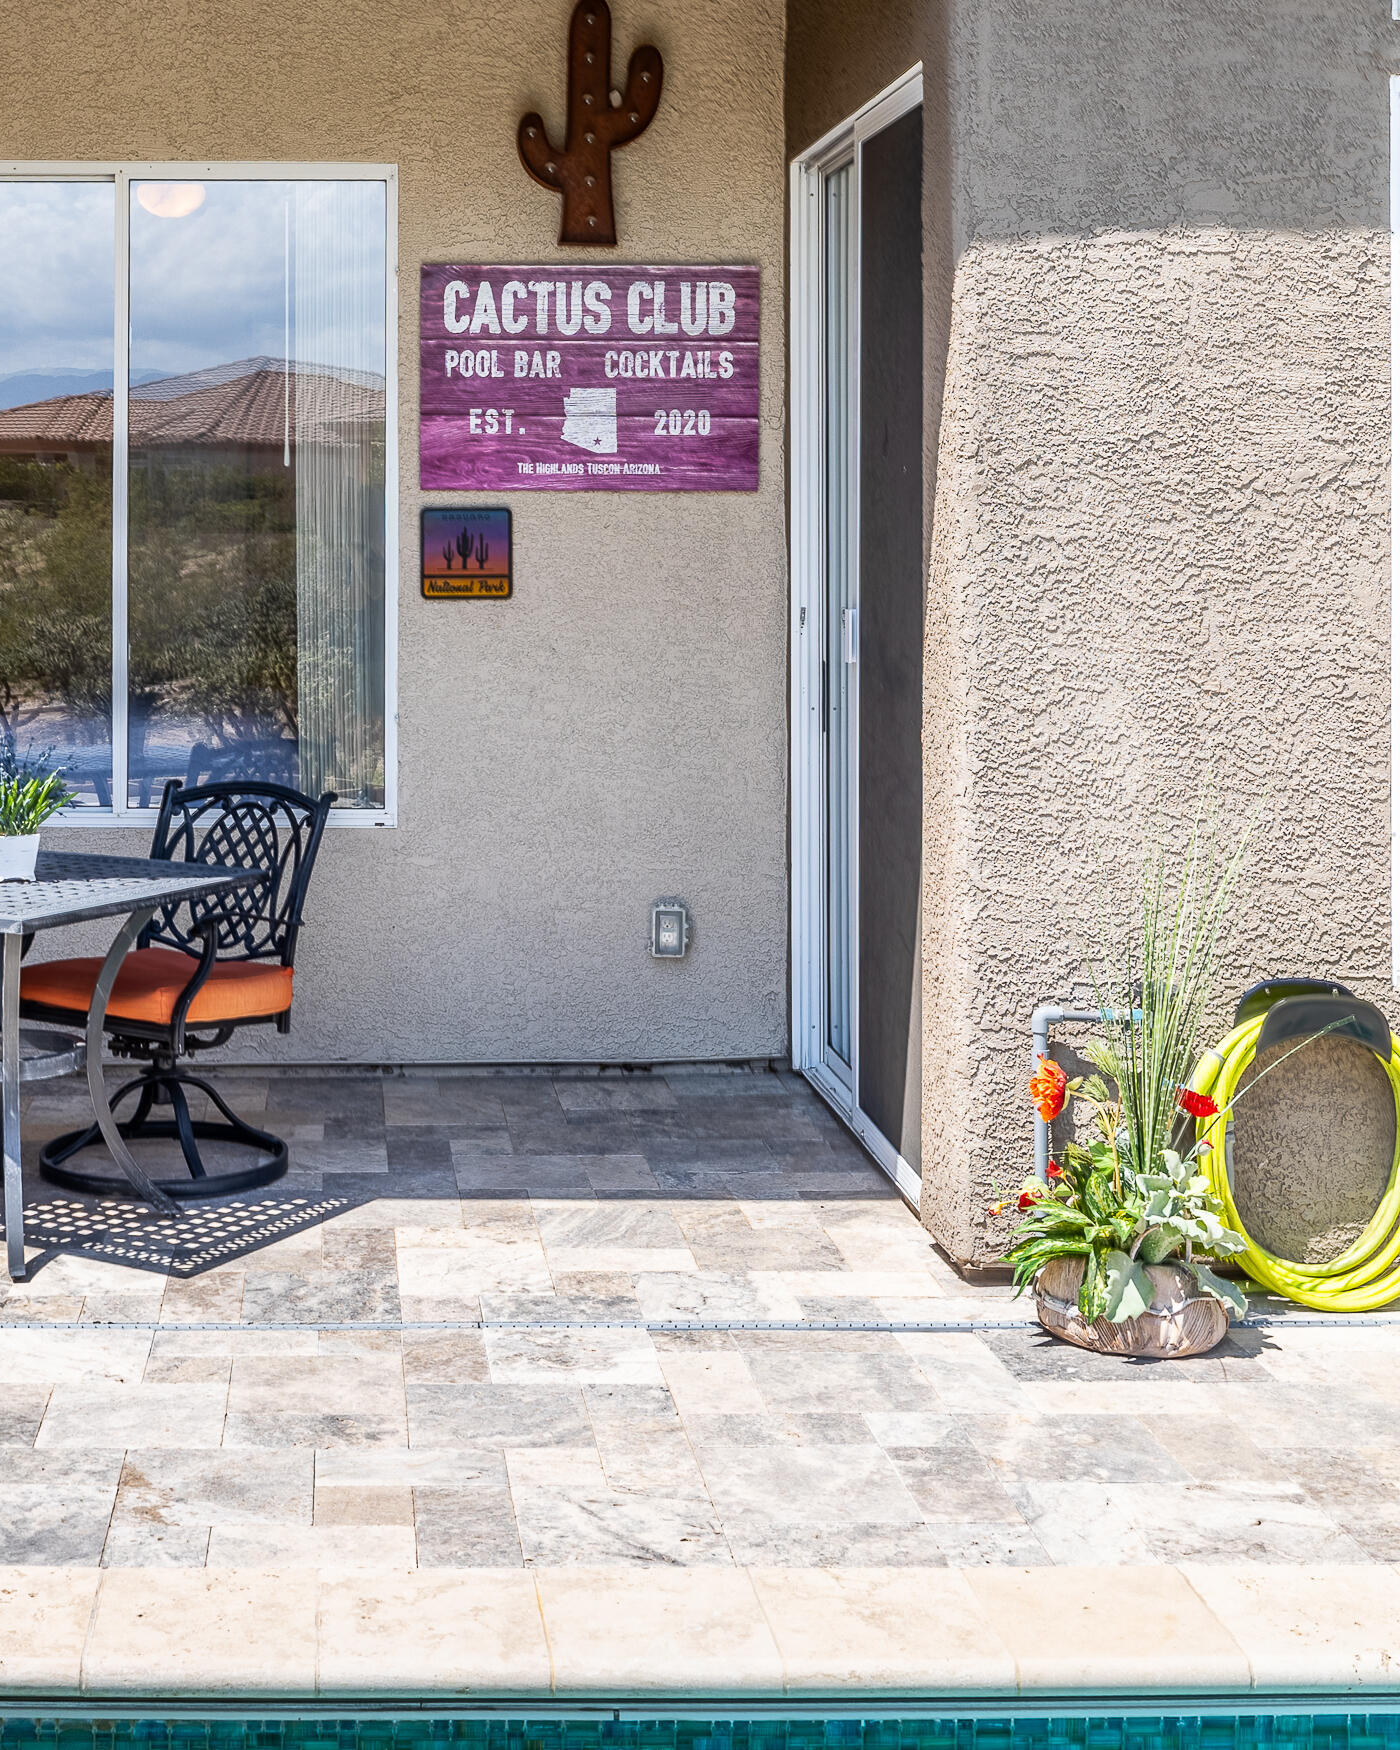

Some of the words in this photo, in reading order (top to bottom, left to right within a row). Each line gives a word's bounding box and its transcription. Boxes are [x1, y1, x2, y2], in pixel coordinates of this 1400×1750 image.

[443, 280, 612, 335] CACTUS
[627, 280, 736, 336] CLUB
[445, 350, 504, 378] POOL
[514, 350, 562, 378] BAR
[604, 350, 734, 379] COCKTAILS
[469, 408, 526, 435] EST.
[654, 409, 711, 435] 2020
[517, 462, 534, 475] THE
